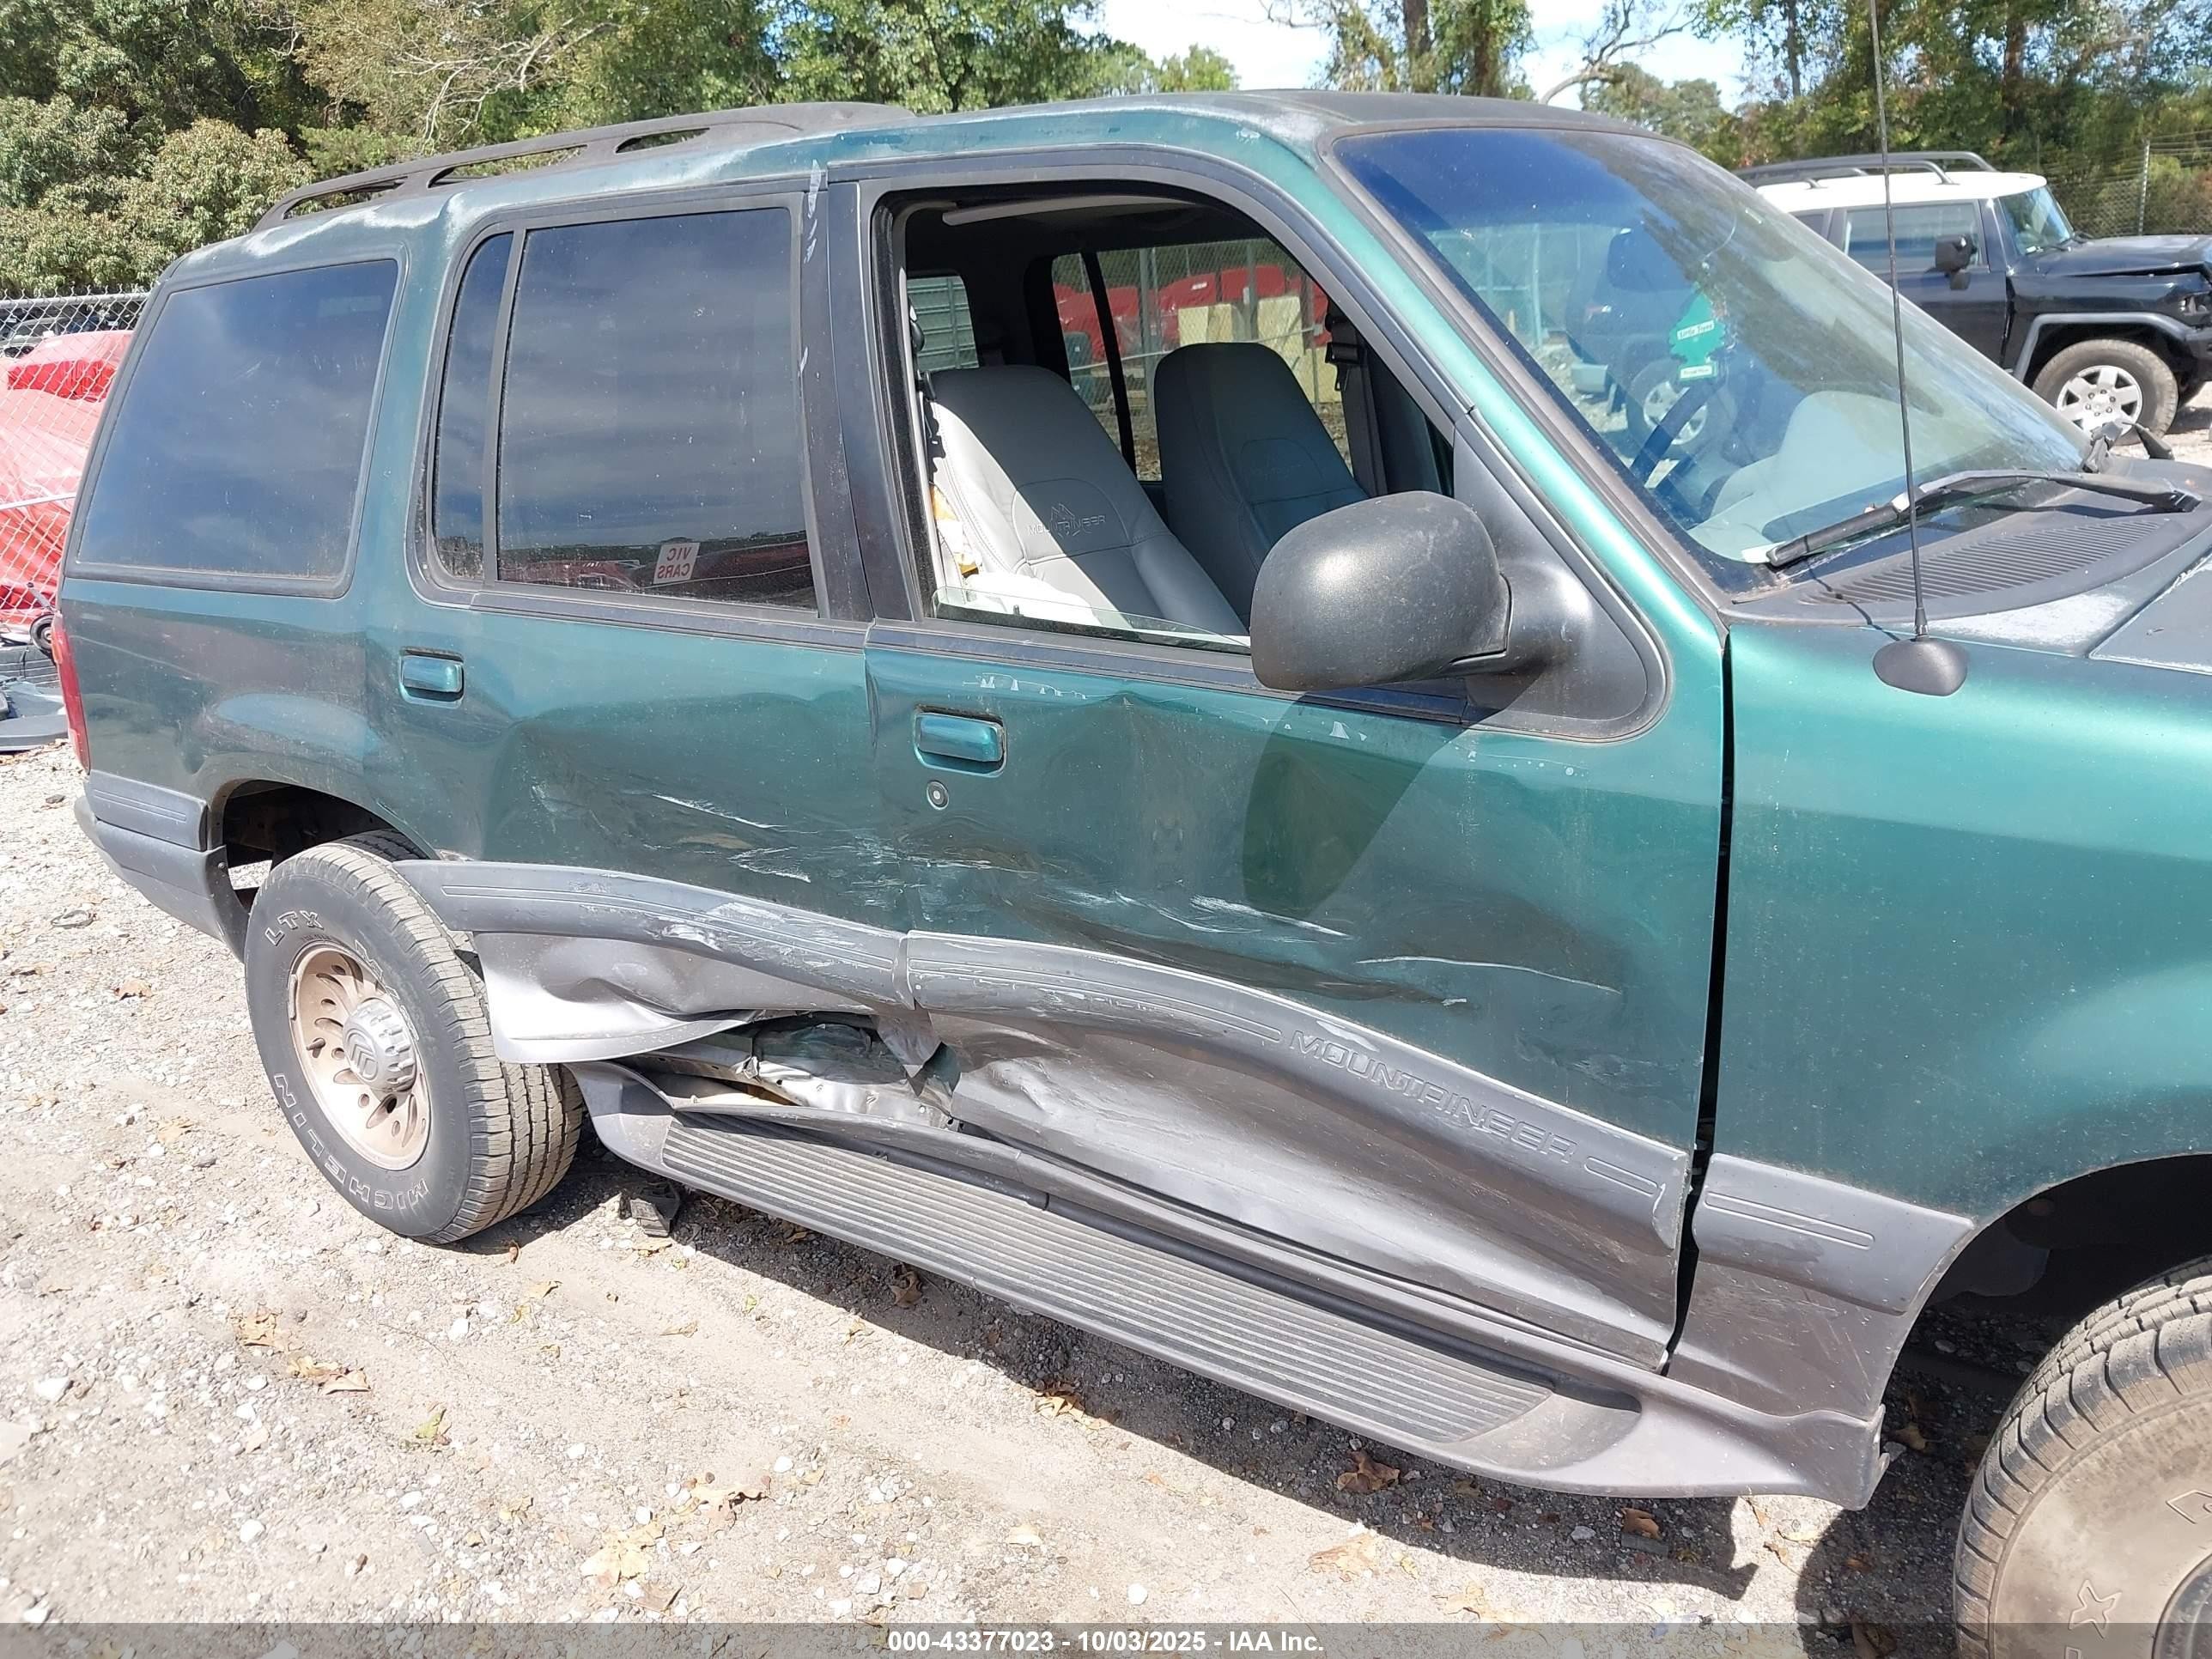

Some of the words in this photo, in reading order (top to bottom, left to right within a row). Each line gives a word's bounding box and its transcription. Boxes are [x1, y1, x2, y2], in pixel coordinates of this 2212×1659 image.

[264, 910, 324, 946] LTX
[274, 1073, 431, 1211] MICHELIN
[1290, 1030, 1578, 1164] MOUNTAINEER
